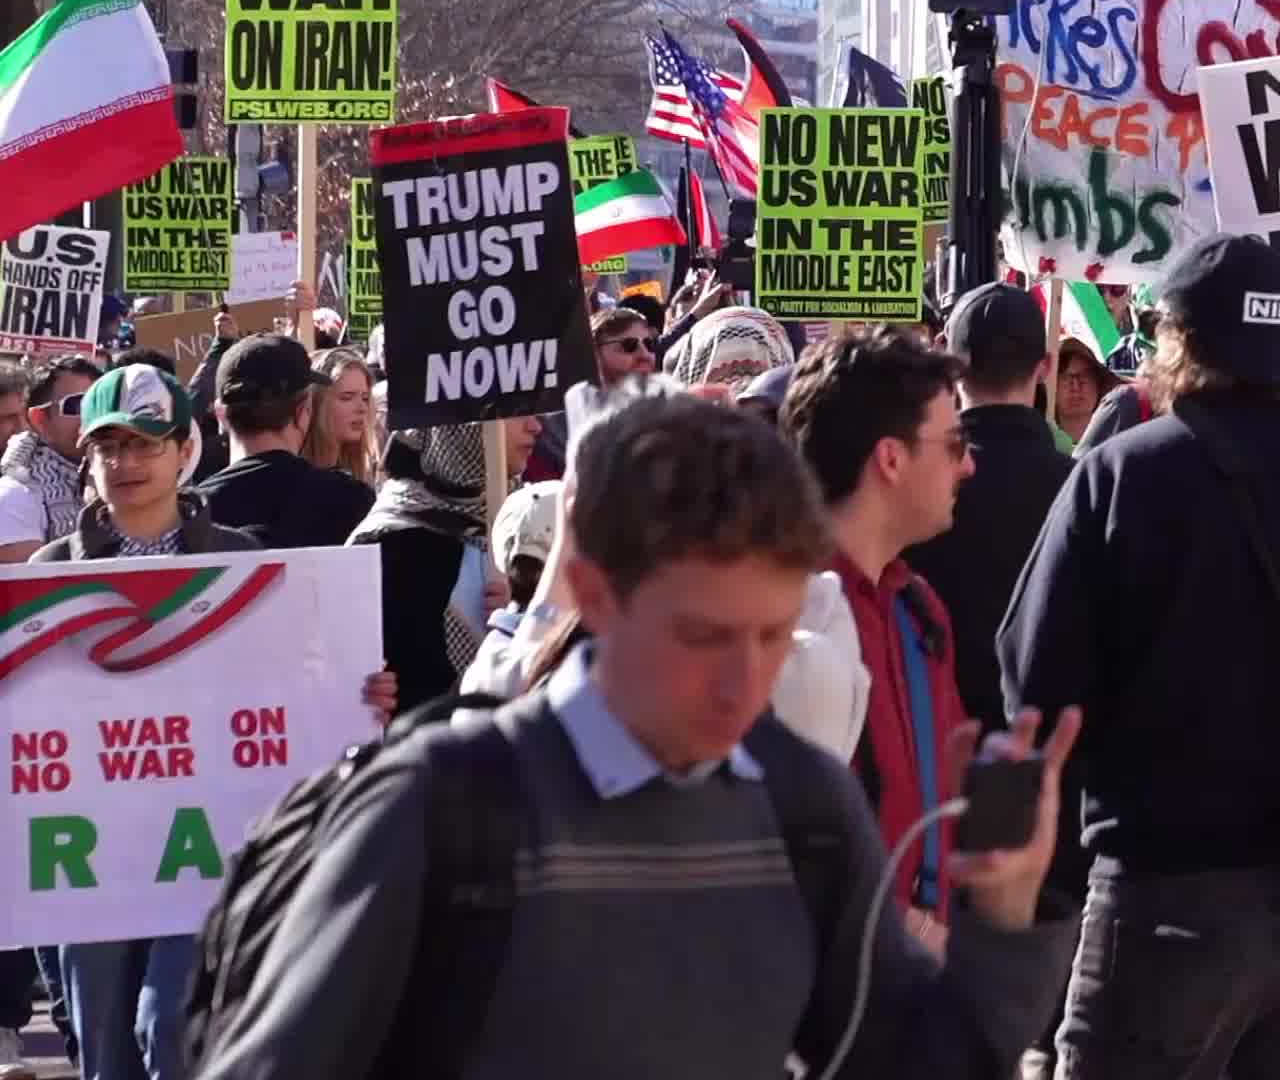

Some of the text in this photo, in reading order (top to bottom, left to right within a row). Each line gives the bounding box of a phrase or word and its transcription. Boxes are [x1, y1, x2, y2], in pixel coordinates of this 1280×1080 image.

[231, 20, 392, 91] ON IRAN!
[231, 101, 390, 119] PSLWEB.ORG
[913, 77, 946, 116] NO
[996, 65, 1149, 156] PEACE
[764, 114, 921, 167] NO NEW
[169, 162, 228, 195] NEW
[573, 149, 614, 176] THE
[383, 161, 560, 230] TRUMP
[762, 169, 818, 207] US
[822, 170, 919, 207] WAR
[126, 197, 228, 220] US WAR
[127, 227, 228, 249] IN THE
[406, 221, 544, 287] MUST
[761, 218, 917, 251] IN THE
[2, 264, 62, 290] HANDS
[67, 269, 101, 293] OFF
[128, 250, 186, 274] MIDDLE
[190, 250, 229, 274] EAST
[761, 254, 917, 293] MIDDLE EAST
[0, 291, 91, 339] IRAN
[448, 285, 516, 341] GO
[425, 338, 559, 405] NOW!
[12, 707, 285, 761] NO WAR ON
[12, 738, 288, 794] NO WAR ON
